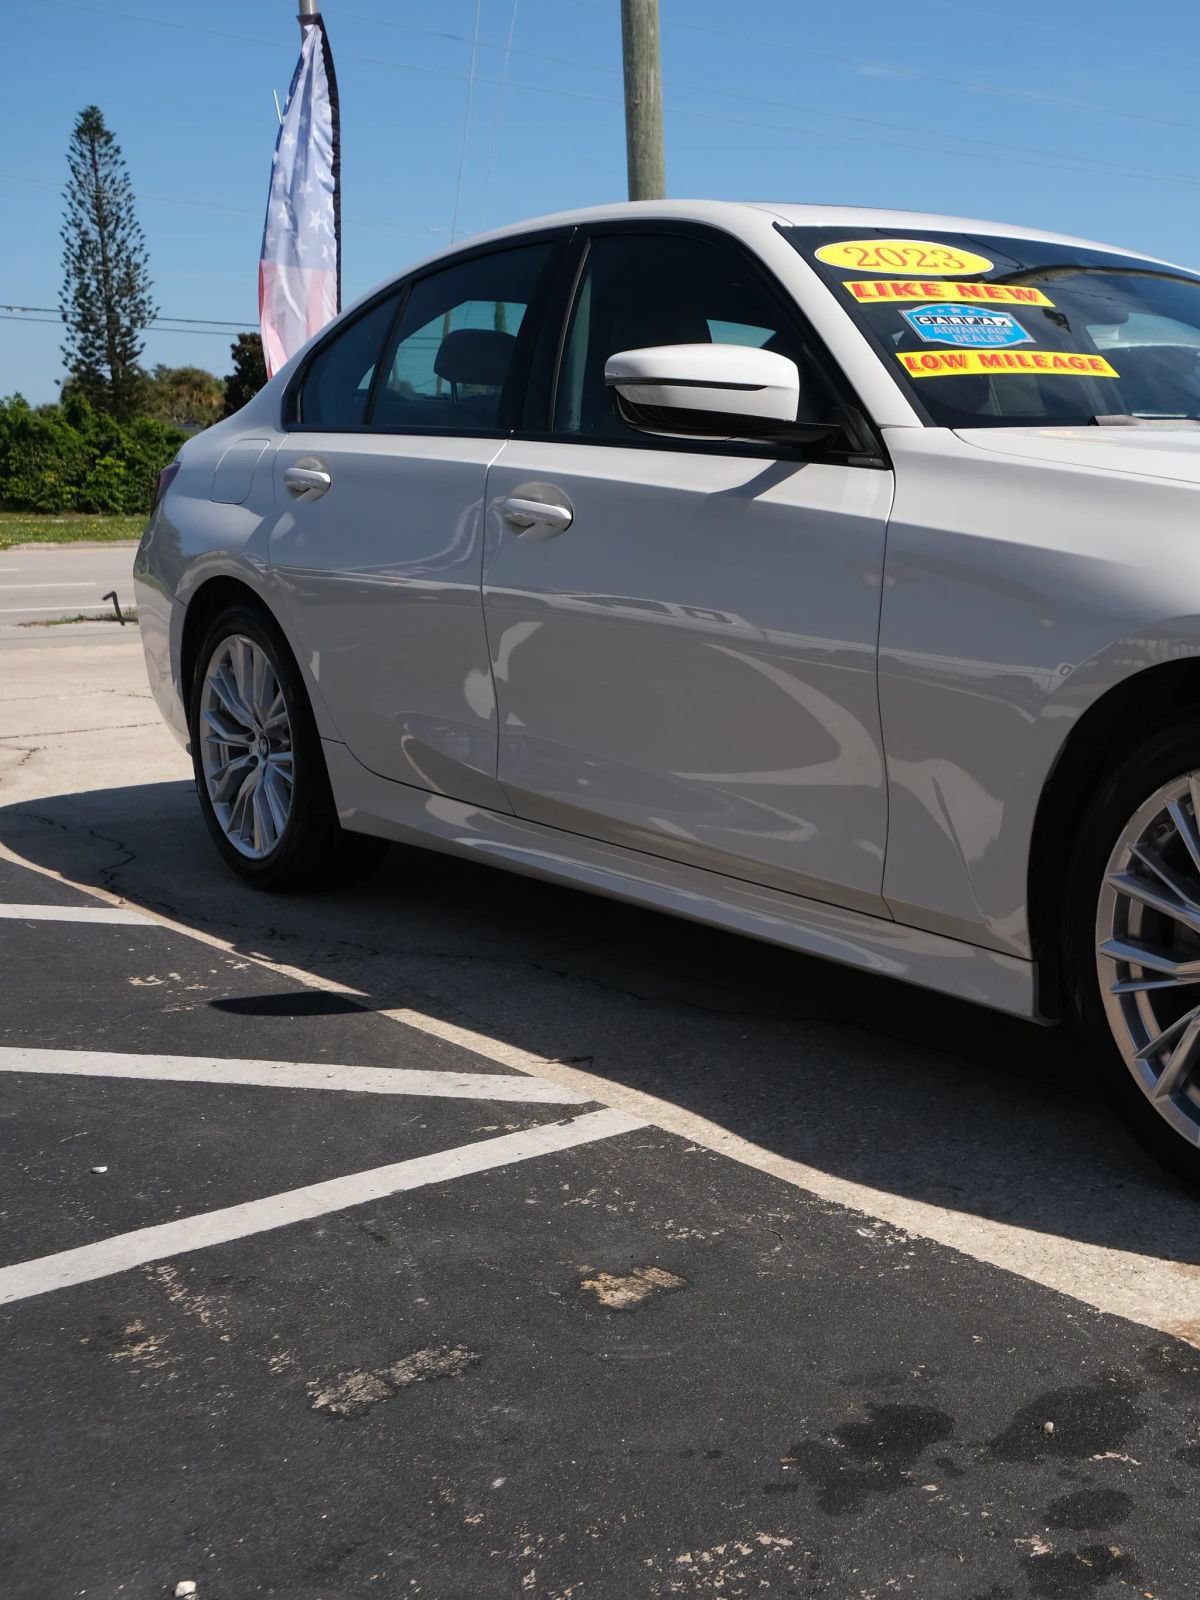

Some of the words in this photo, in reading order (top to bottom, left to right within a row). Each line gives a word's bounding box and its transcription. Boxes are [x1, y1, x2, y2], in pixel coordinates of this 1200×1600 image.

[843, 246, 965, 270] 2023
[851, 282, 943, 300] LIKE
[957, 283, 1042, 303] NEW
[916, 316, 1013, 327] CARFAX
[933, 326, 1014, 336] ADVANTAGE
[953, 334, 1009, 344] DEALER
[904, 353, 970, 372] LOW
[980, 353, 1107, 373] MILEAGE
